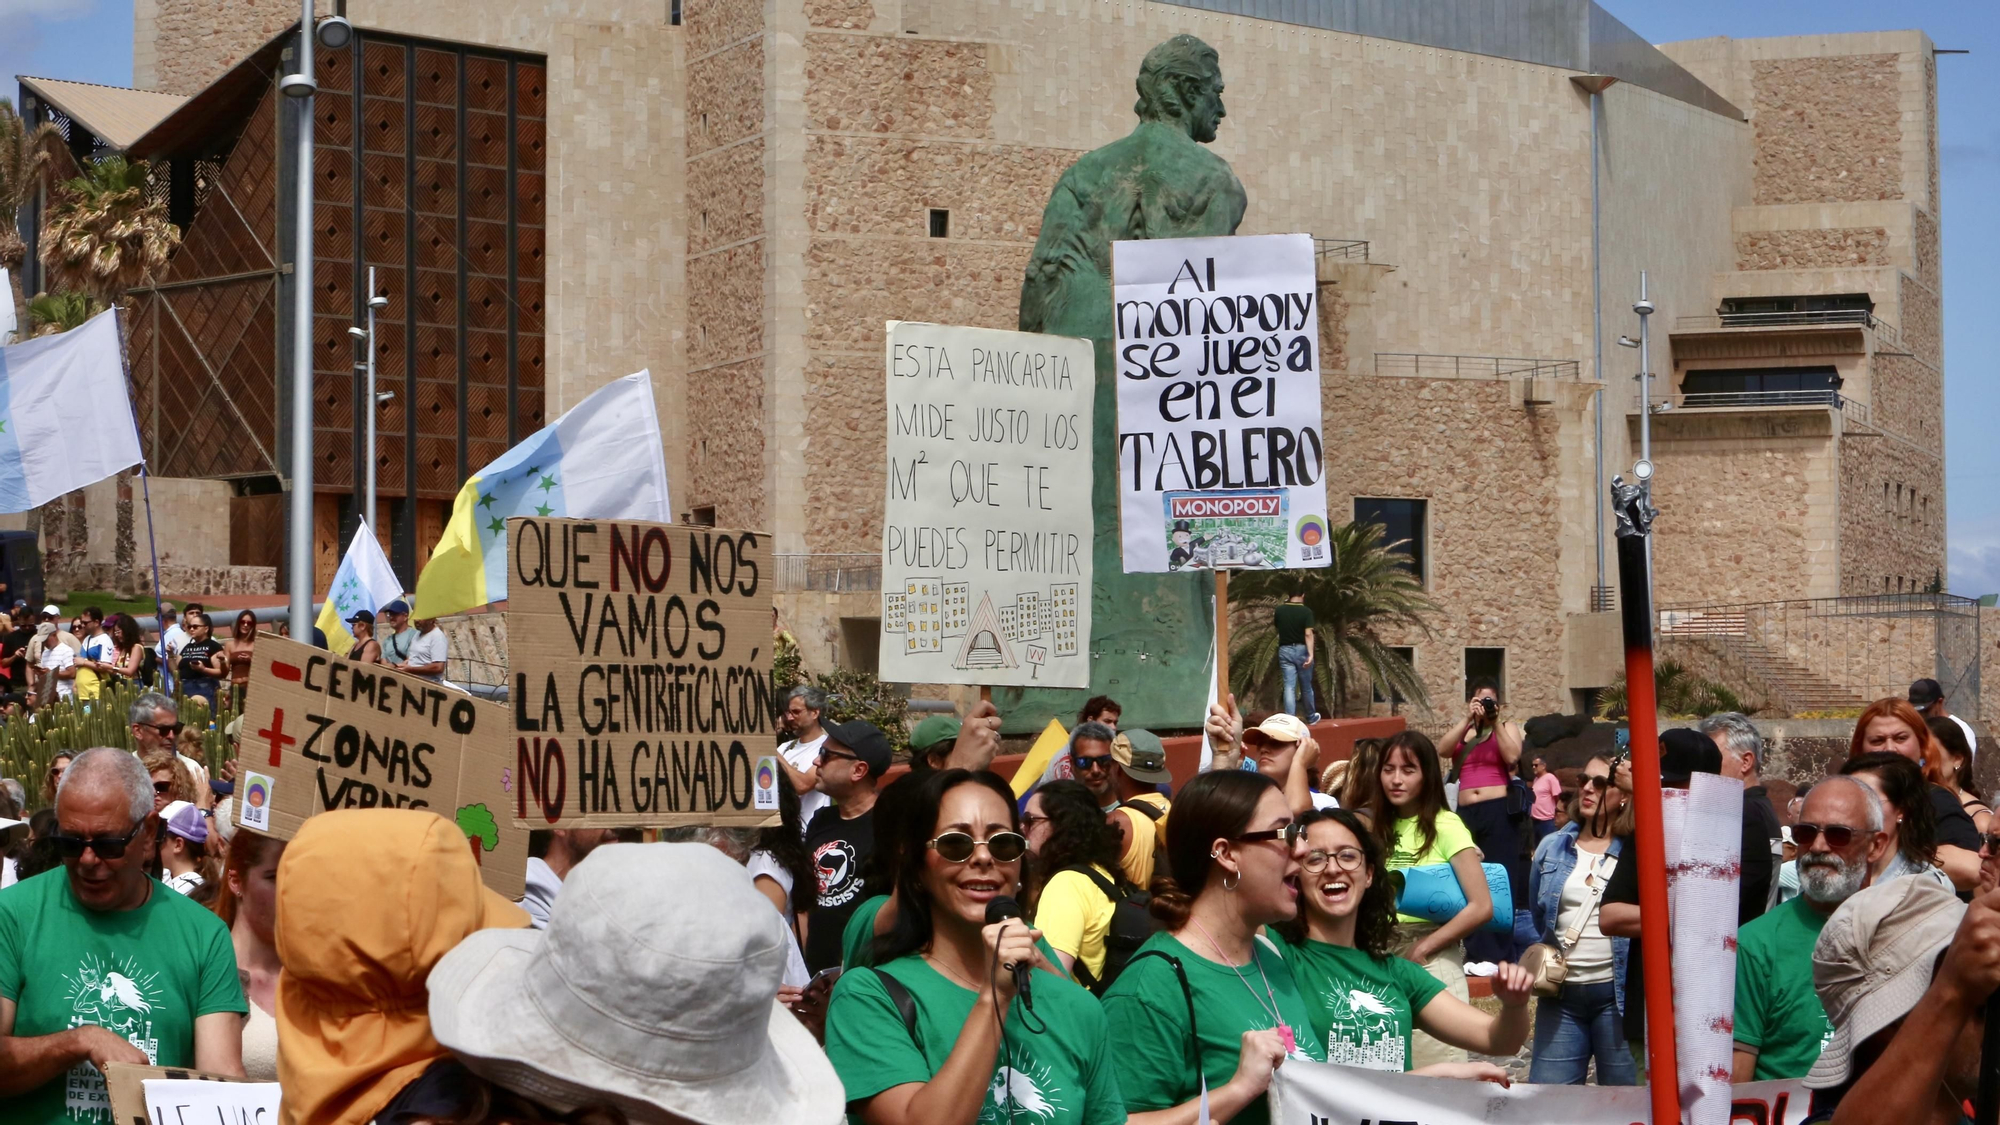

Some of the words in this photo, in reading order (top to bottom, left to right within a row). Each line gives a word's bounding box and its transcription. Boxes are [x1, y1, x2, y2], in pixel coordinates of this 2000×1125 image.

[893, 344, 954, 380] ESTA
[972, 348, 1073, 391] PANCARTA
[1122, 342, 1181, 380] se
[1197, 334, 1312, 376] juega
[895, 403, 955, 440] MIDE
[969, 406, 1029, 444] JUSTO
[1044, 412, 1079, 450] LOS
[1119, 426, 1323, 491] TABLERO
[950, 459, 1000, 508] QUE
[1024, 464, 1052, 510] TE
[1175, 498, 1278, 515] MONOPOLY
[516, 519, 599, 589] QUE
[610, 523, 671, 595] NO
[690, 531, 758, 597] NOS
[889, 525, 968, 570] PUEDES
[985, 529, 1080, 575] PERMITIR
[558, 591, 725, 661] VAMOS
[304, 655, 476, 735] CEMENTO
[516, 671, 564, 733] LA
[302, 714, 435, 788] ZONAS
[517, 736, 566, 824] NO
[578, 738, 621, 813] HA
[631, 740, 752, 813] GANADO
[69, 1078, 89, 1089] EN
[69, 1091, 85, 1100] DE
